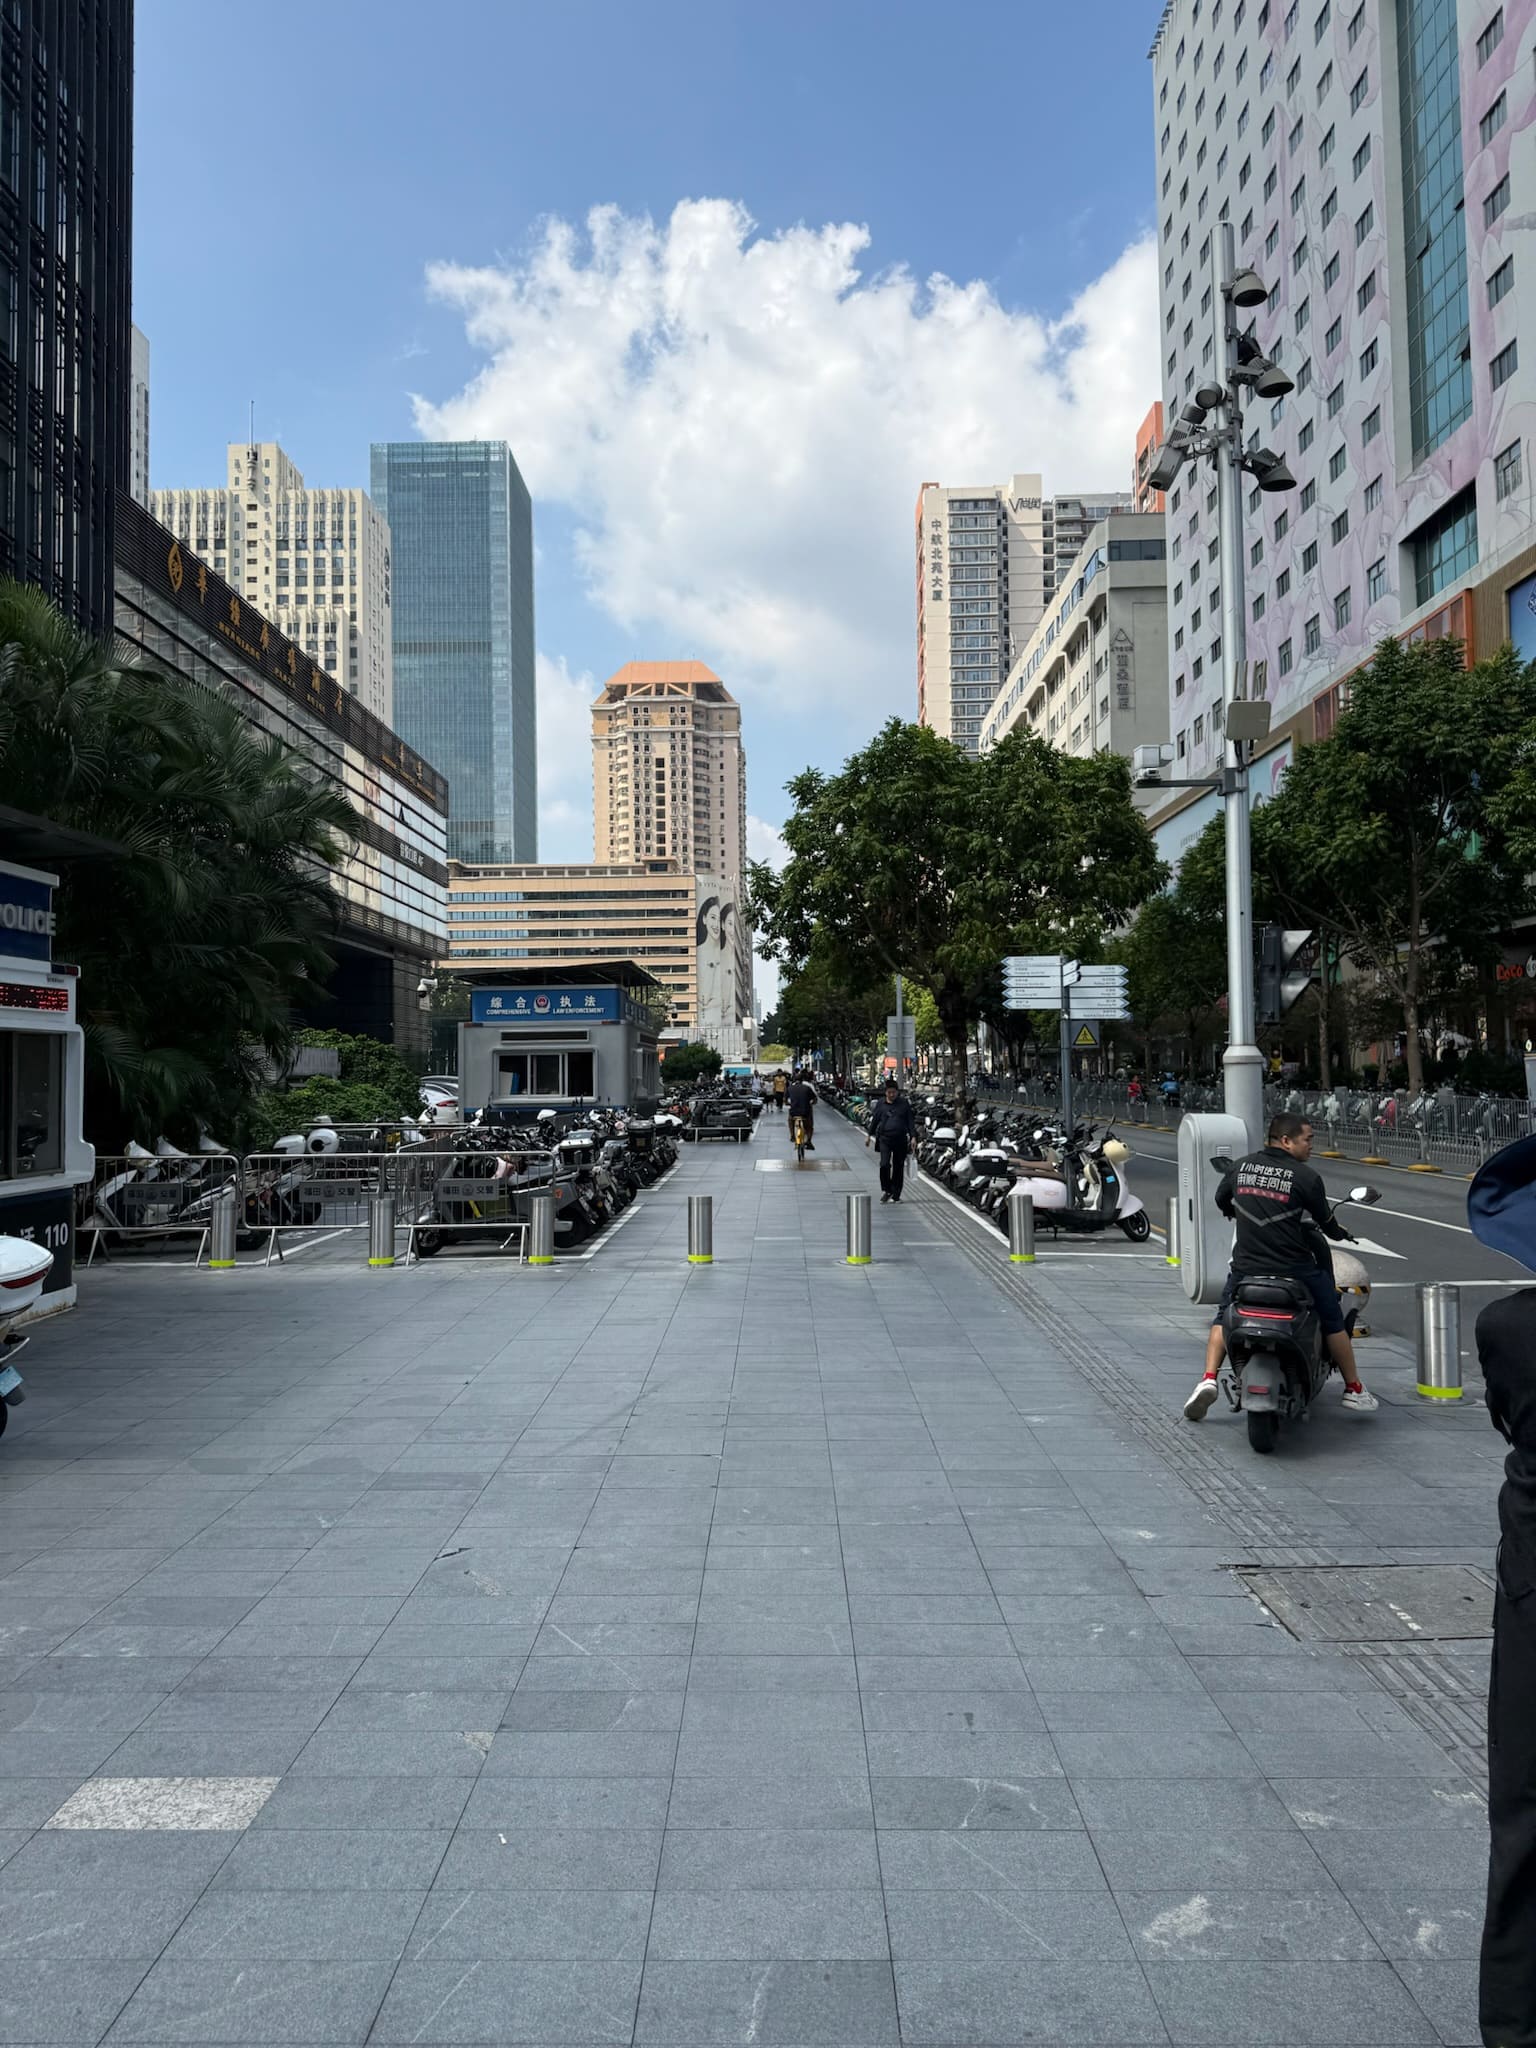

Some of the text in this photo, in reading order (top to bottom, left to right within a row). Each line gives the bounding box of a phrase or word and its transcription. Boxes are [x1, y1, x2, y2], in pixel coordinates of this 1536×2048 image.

[1237, 1172, 1293, 1194] 用顺丰同城
[45, 1222, 69, 1248] 110
